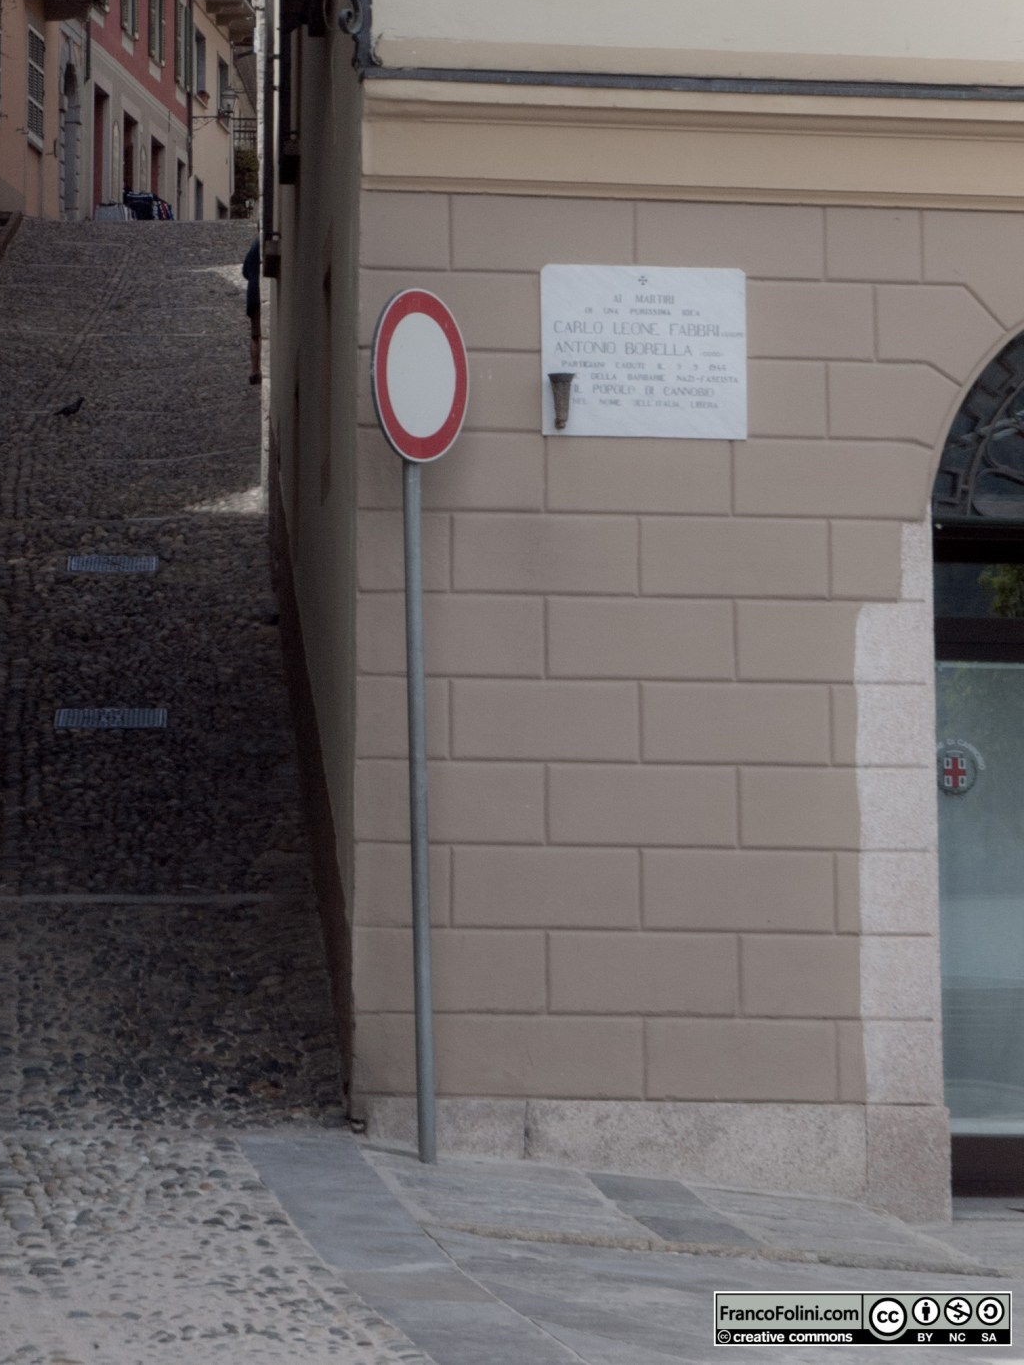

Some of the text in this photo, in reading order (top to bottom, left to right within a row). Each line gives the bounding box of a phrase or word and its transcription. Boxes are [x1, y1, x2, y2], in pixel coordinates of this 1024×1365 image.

[635, 295, 675, 304] MARTIRI
[630, 308, 671, 316] PURISSIMA
[553, 320, 603, 334] CARLO
[613, 322, 659, 336] LEONE
[669, 323, 720, 337] FABBRI
[553, 341, 616, 354] ANTONIO
[625, 342, 692, 356] BORELLA
[561, 360, 605, 368] PARTIGIANI
[616, 362, 645, 370] CADUTI
[627, 374, 666, 382] BARBARIE
[677, 375, 738, 383] NAZI-FASCISTA
[592, 386, 635, 395] POPOLO
[645, 387, 654, 396] DI
[664, 387, 714, 397] CANNOBIO
[691, 401, 718, 409] LIBERA
